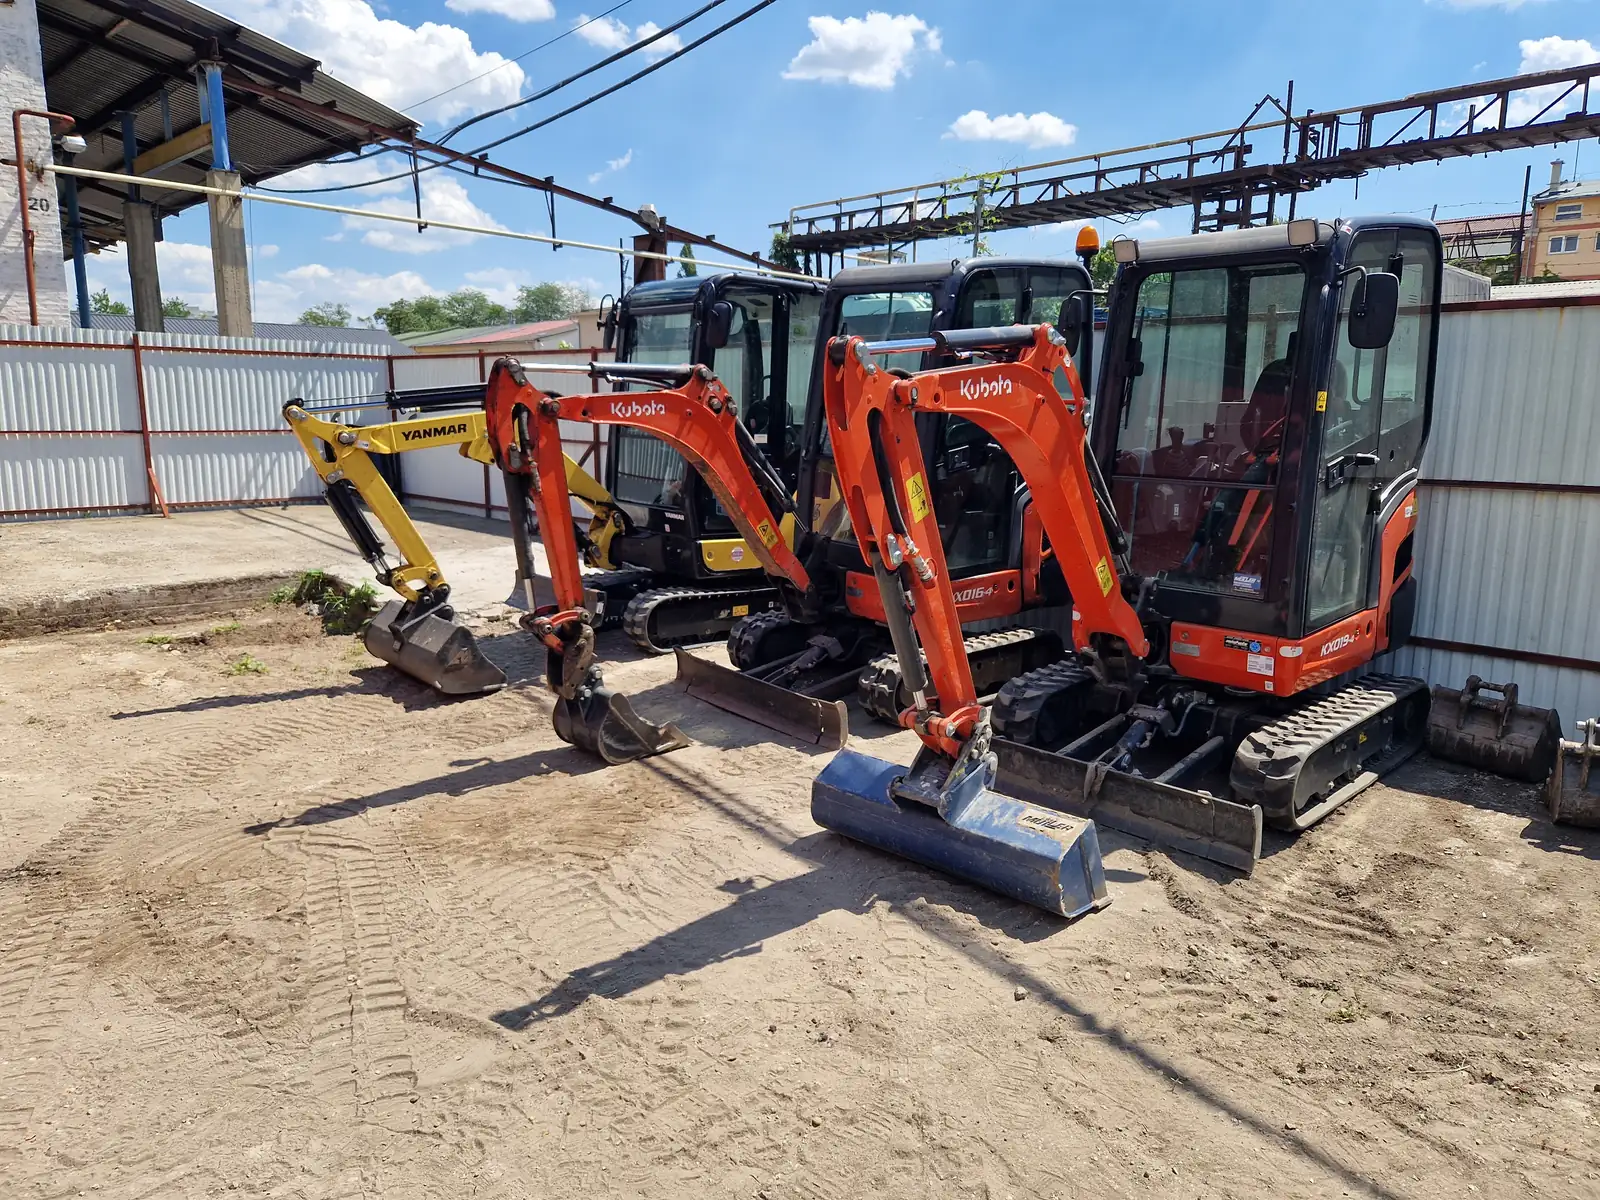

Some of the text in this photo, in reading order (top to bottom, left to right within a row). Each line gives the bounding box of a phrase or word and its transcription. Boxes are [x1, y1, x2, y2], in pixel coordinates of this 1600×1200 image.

[28, 196, 50, 212] 20
[960, 374, 1012, 400] Kubota
[610, 400, 665, 418] Kubota
[401, 424, 467, 441] YANMAR
